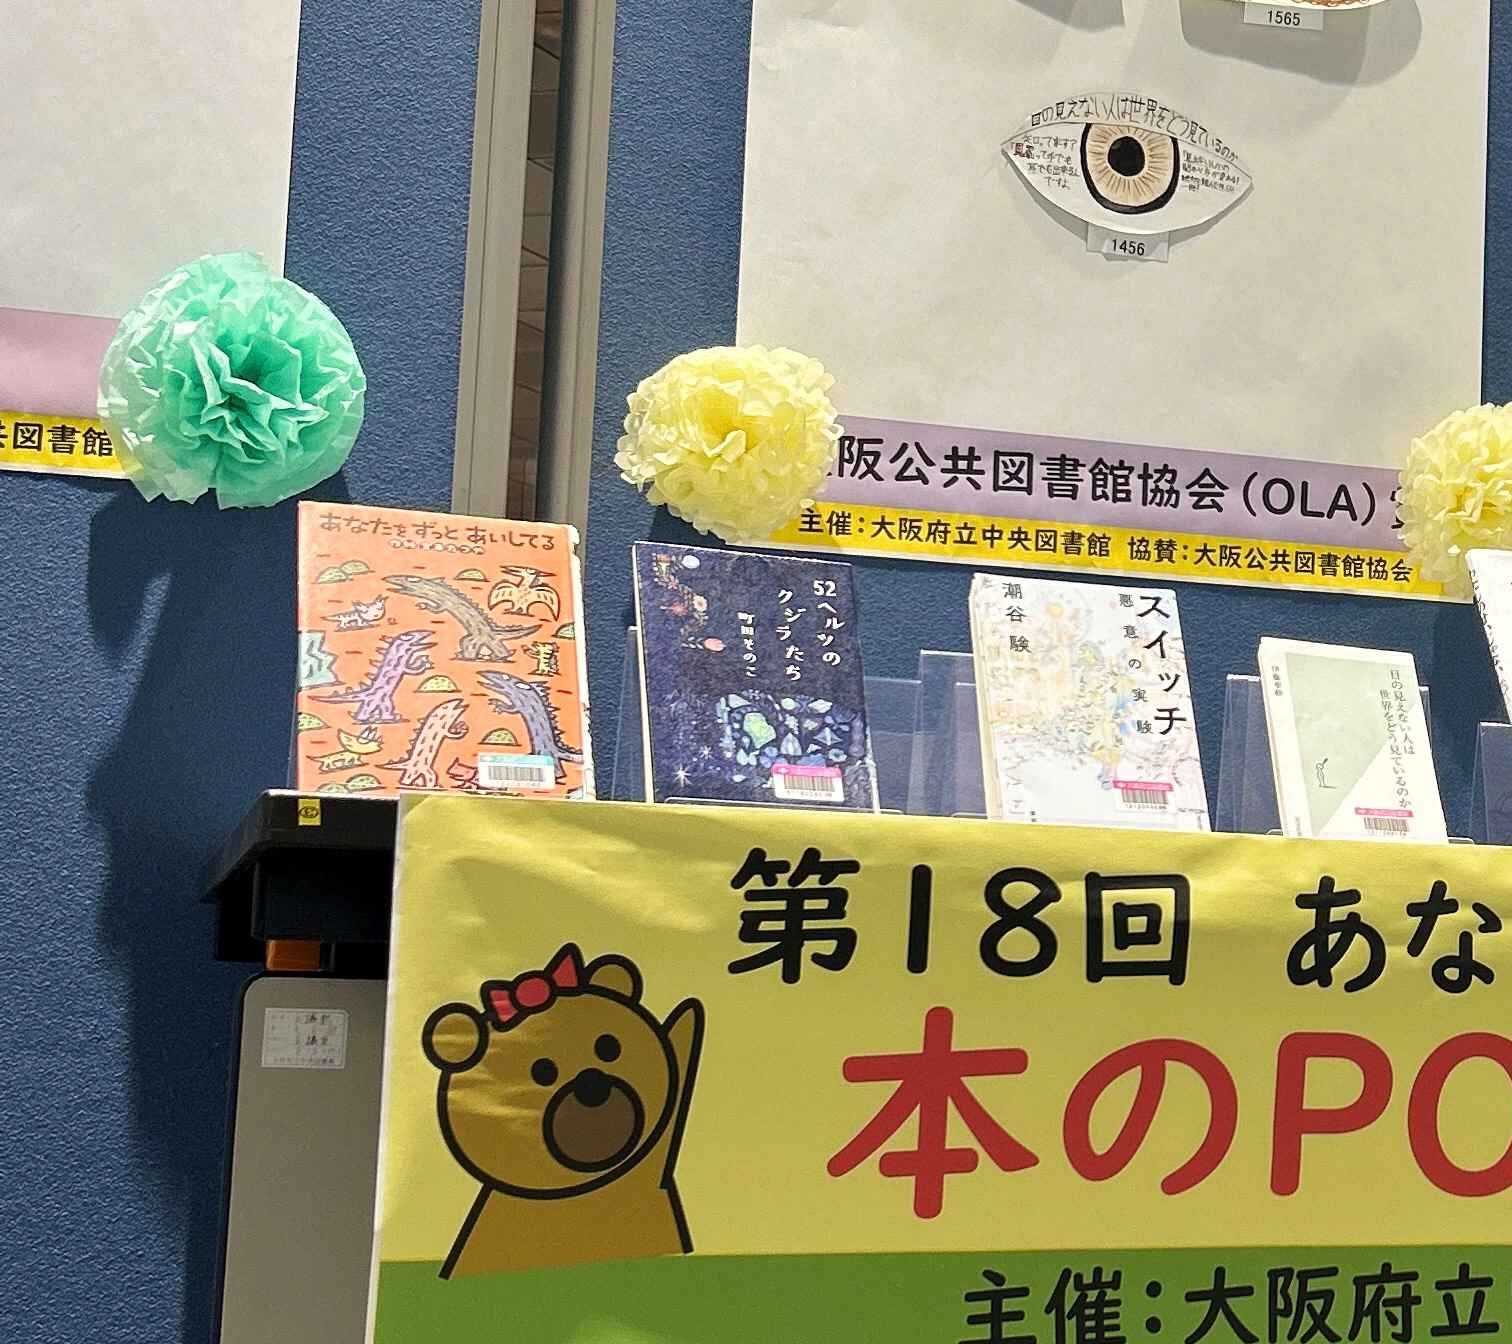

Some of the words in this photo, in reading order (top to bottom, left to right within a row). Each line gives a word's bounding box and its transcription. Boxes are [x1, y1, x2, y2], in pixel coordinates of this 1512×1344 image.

[1267, 10, 1301, 27] 1565
[1112, 239, 1145, 257] 1456
[0, 420, 113, 457] 図書館
[827, 435, 1405, 531] 阪公共図書館協会（OLA）
[798, 507, 1112, 558] 主催：大阪府立中央図書館
[1127, 535, 1413, 584] 協賛：大阪公共図書館協会
[737, 612, 758, 677] 町田そのこ
[776, 590, 806, 681] クジラたち
[813, 580, 845, 666] 52ヘルツの
[1002, 582, 1031, 654] 潮谷験
[1137, 595, 1187, 735] スイッチ
[728, 847, 1192, 986] 第18回
